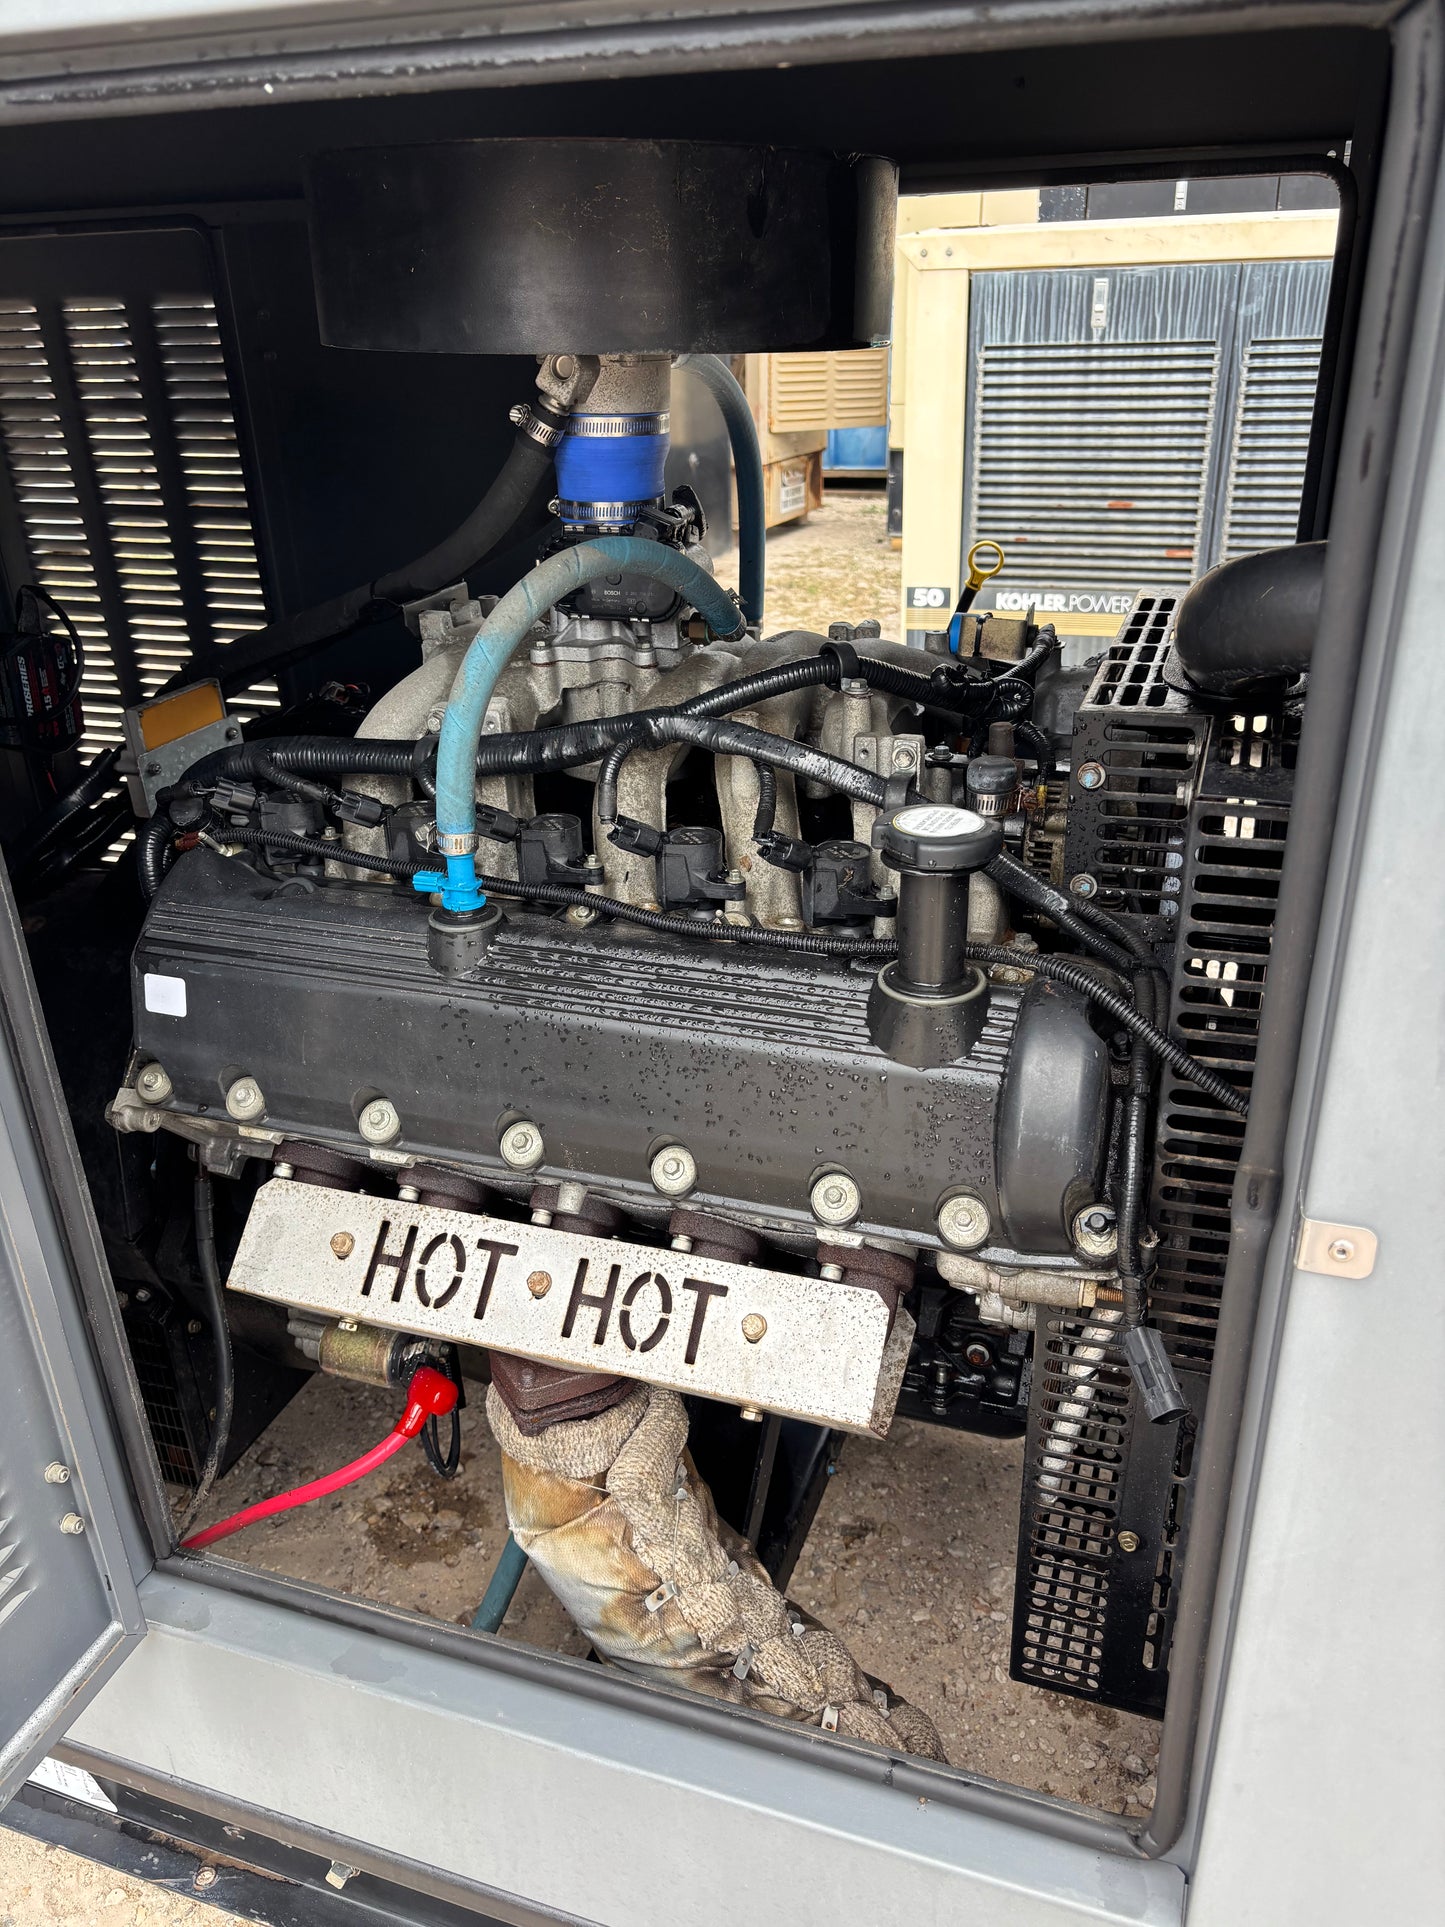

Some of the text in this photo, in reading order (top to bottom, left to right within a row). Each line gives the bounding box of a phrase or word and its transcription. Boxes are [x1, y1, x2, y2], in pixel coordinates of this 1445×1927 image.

[913, 587, 945, 608] 50
[996, 592, 1133, 613] KOHLER POWER
[361, 1220, 728, 1364] HOT HOT
